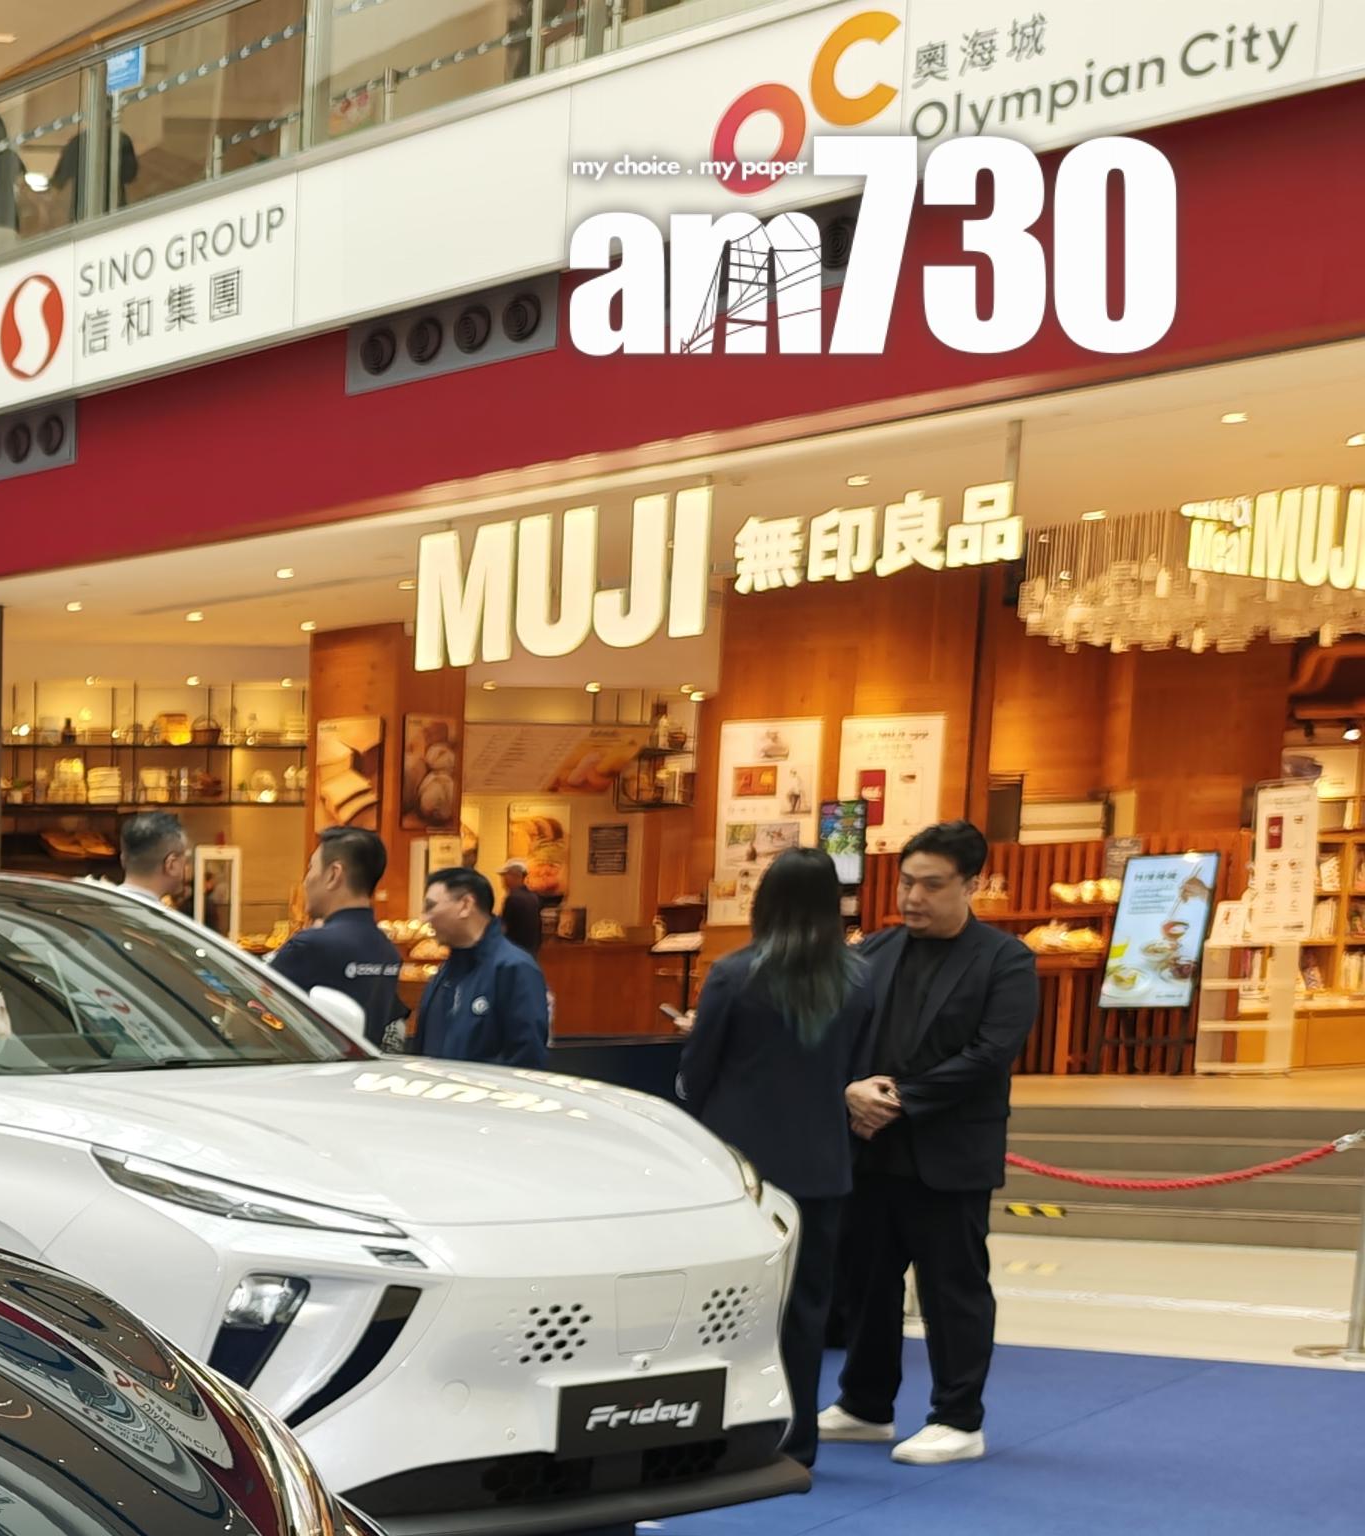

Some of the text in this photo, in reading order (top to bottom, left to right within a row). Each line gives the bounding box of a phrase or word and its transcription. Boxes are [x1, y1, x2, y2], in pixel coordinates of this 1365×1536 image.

[910, 22, 1297, 142] Olympian City
[77, 205, 285, 298] SINO GROUP
[78, 267, 245, 359] 信和集團
[414, 485, 715, 672] MUJI
[734, 480, 1024, 596] 無印良品
[585, 1399, 702, 1431] Friday
